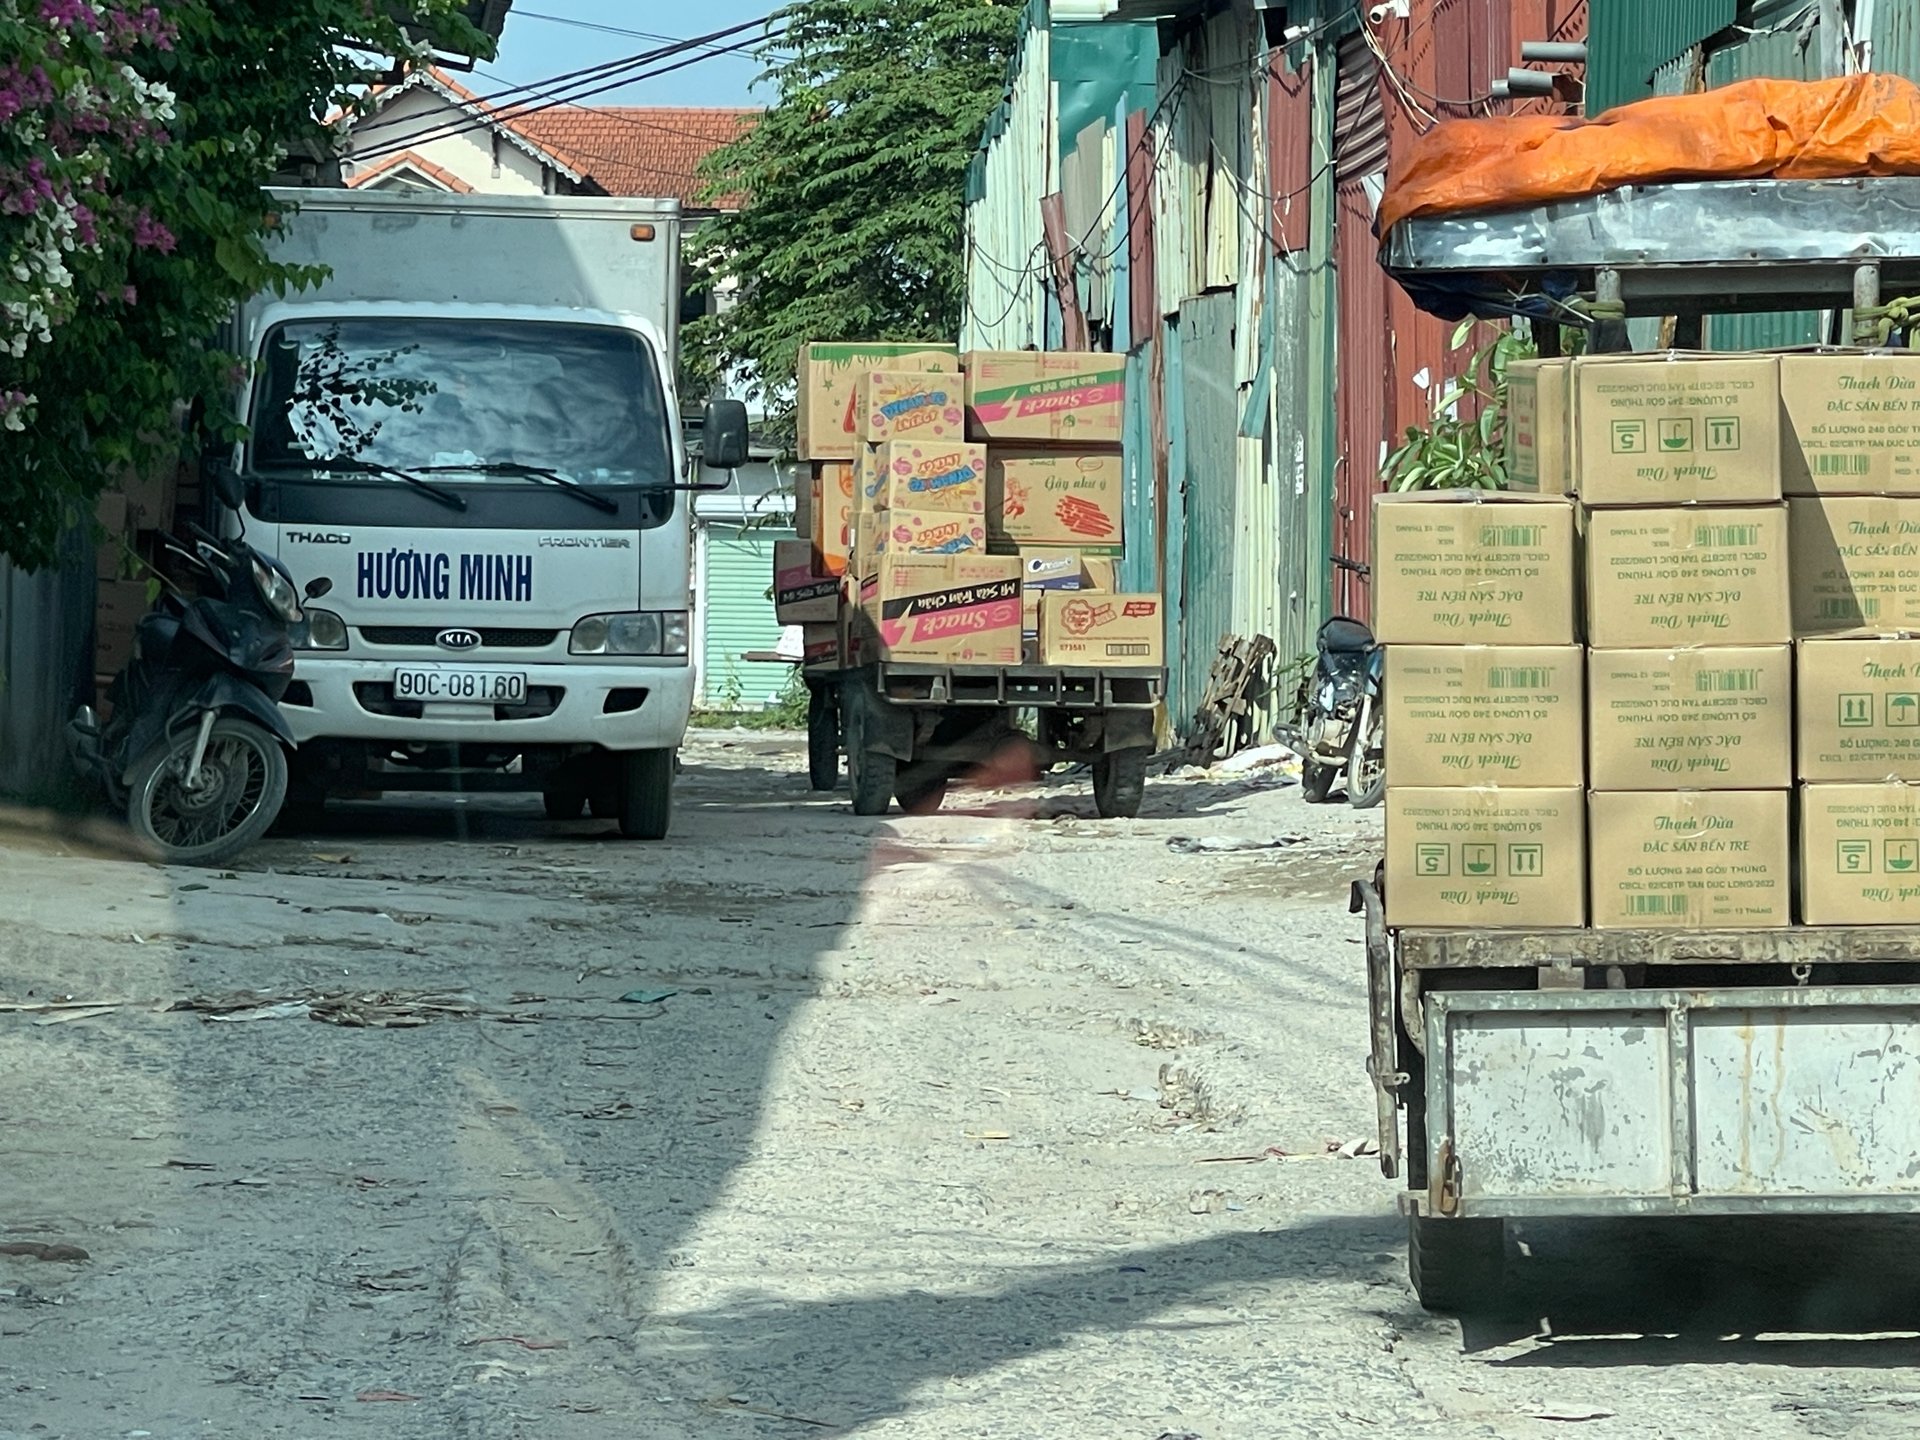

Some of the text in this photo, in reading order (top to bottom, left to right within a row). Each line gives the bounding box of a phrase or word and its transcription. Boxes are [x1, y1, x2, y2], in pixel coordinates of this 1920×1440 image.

[1025, 393, 1082, 413] Snack
[1620, 433, 1634, 449] 5
[287, 532, 351, 545] THACO
[538, 536, 631, 548] FRONTIER
[357, 547, 533, 601] HƯƠNG MINH
[1416, 591, 1438, 601] TRE
[1633, 594, 1655, 605] TRE
[922, 610, 988, 634] Snack
[446, 634, 471, 644] KIA
[1425, 733, 1446, 744] TRE
[1633, 738, 1655, 748] TRE
[1729, 841, 1750, 851] TRE
[1425, 857, 1439, 872] 5
[1847, 854, 1859, 869] 5
